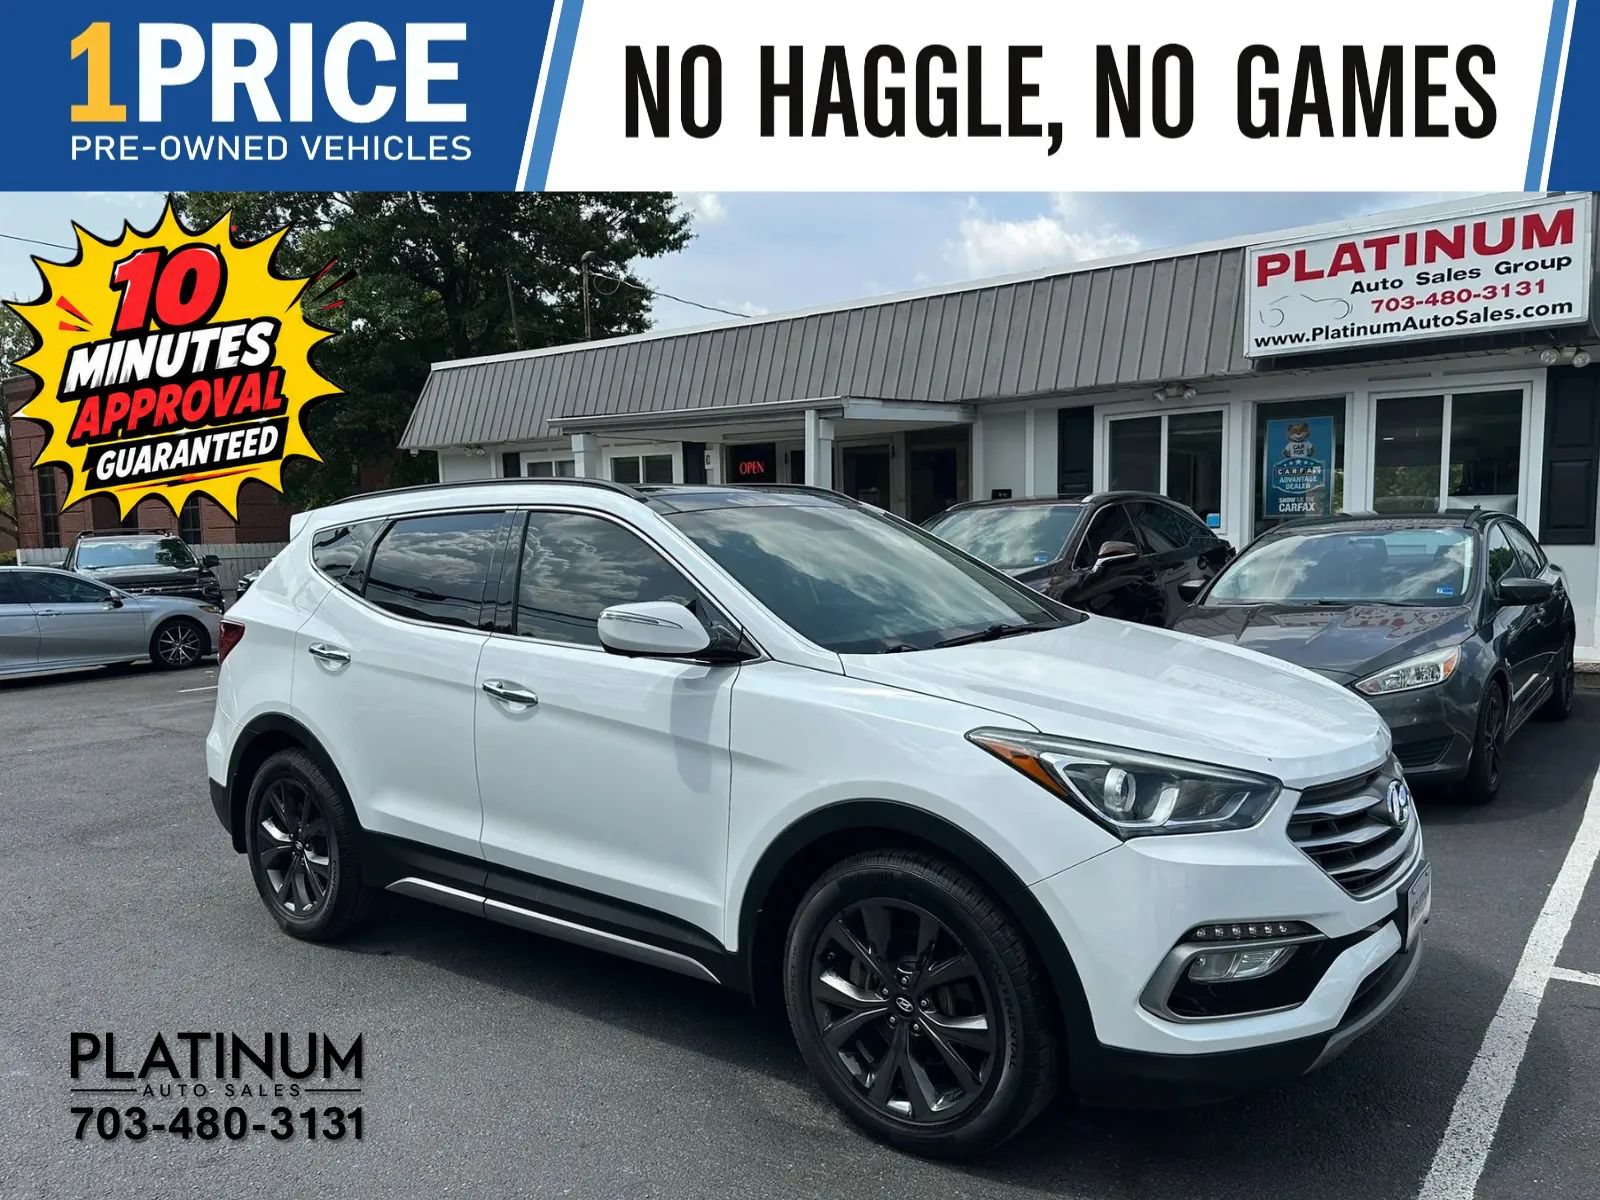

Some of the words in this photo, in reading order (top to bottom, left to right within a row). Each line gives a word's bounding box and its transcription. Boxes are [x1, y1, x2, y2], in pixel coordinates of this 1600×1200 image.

[1256, 207, 1574, 288] PLATINUM
[1350, 279, 1403, 295] Auto
[1415, 267, 1481, 286] Sales
[1494, 255, 1572, 275] Group
[1371, 278, 1545, 314] 703-480-3131
[1254, 301, 1573, 348] www.PlatinumAutoSales.com
[739, 461, 765, 475] OPEN
[1279, 475, 1318, 484] ADVANTAGE
[1278, 502, 1316, 512] CARFAX
